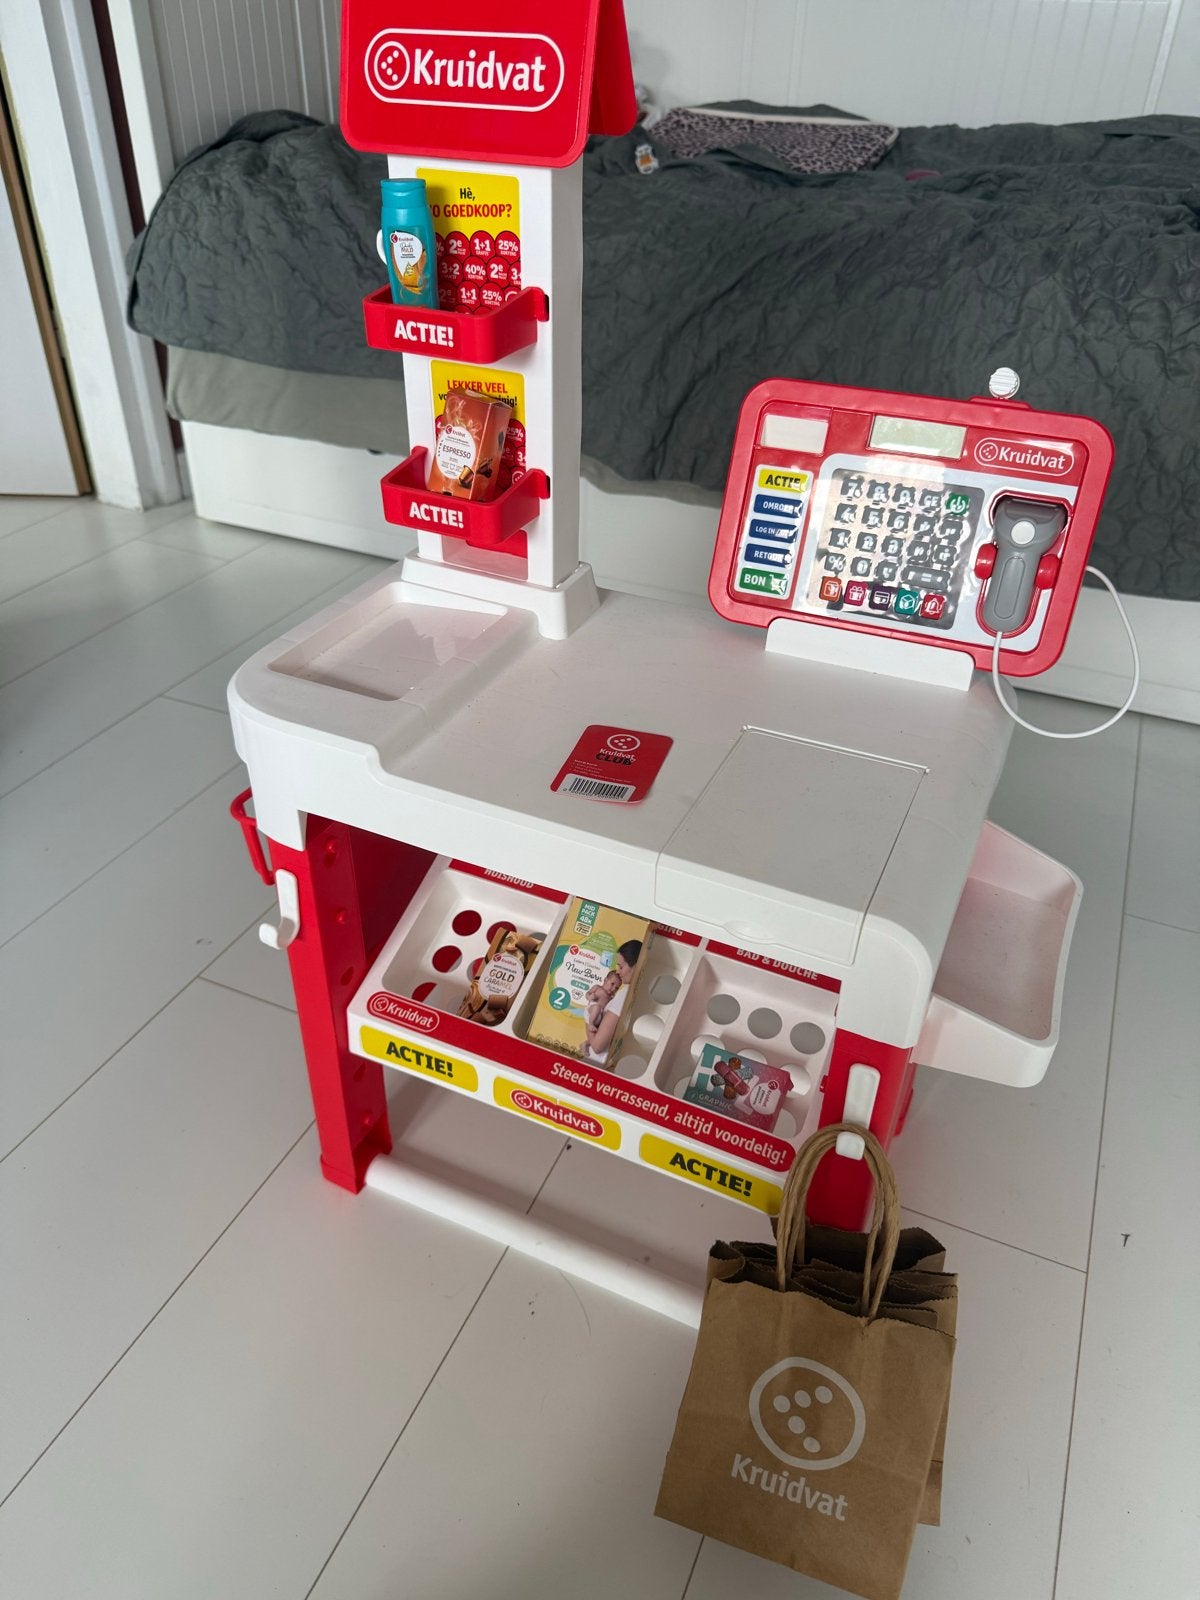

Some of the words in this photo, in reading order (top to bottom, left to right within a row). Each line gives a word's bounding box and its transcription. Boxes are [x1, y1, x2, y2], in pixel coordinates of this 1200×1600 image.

[414, 48, 546, 92] Kruidvat
[460, 187, 476, 201] Hè,
[444, 204, 513, 218] GOEDKOOP?
[474, 238, 492, 252] 1+1
[498, 240, 519, 252] 25%
[441, 262, 460, 275] 3+2
[465, 264, 487, 276] 40%
[460, 287, 477, 300] 1+1
[482, 289, 503, 302] 25%
[394, 319, 454, 348] ACTIE!
[447, 380, 483, 392] LEKKER
[485, 382, 508, 393] VEEL
[443, 445, 472, 459] ESPRESSO
[999, 446, 1066, 470] Kruidvat
[409, 501, 464, 529] ACTIE!
[755, 525, 768, 534] LOG
[744, 573, 766, 586] BON
[596, 753, 632, 766] CLUB
[600, 748, 635, 760] Kruidvat
[581, 908, 596, 917] PACK
[736, 948, 760, 961] BAD
[761, 957, 771, 965] &
[772, 959, 819, 981] DOUCHE
[484, 976, 513, 990] CARAMEL
[490, 969, 515, 983] GOLD
[553, 990, 566, 1006] 2
[387, 1002, 434, 1028] Kruidvat
[386, 1041, 454, 1078] ACTIE!
[533, 1100, 597, 1133] Kruidvat
[550, 1062, 595, 1089] Steeds
[596, 1081, 671, 1121] verrassend,
[673, 1111, 713, 1135] altijd
[715, 1127, 788, 1165] voordelig!
[669, 1152, 752, 1197] ACTIE!
[731, 1453, 848, 1522] Kruidvat
